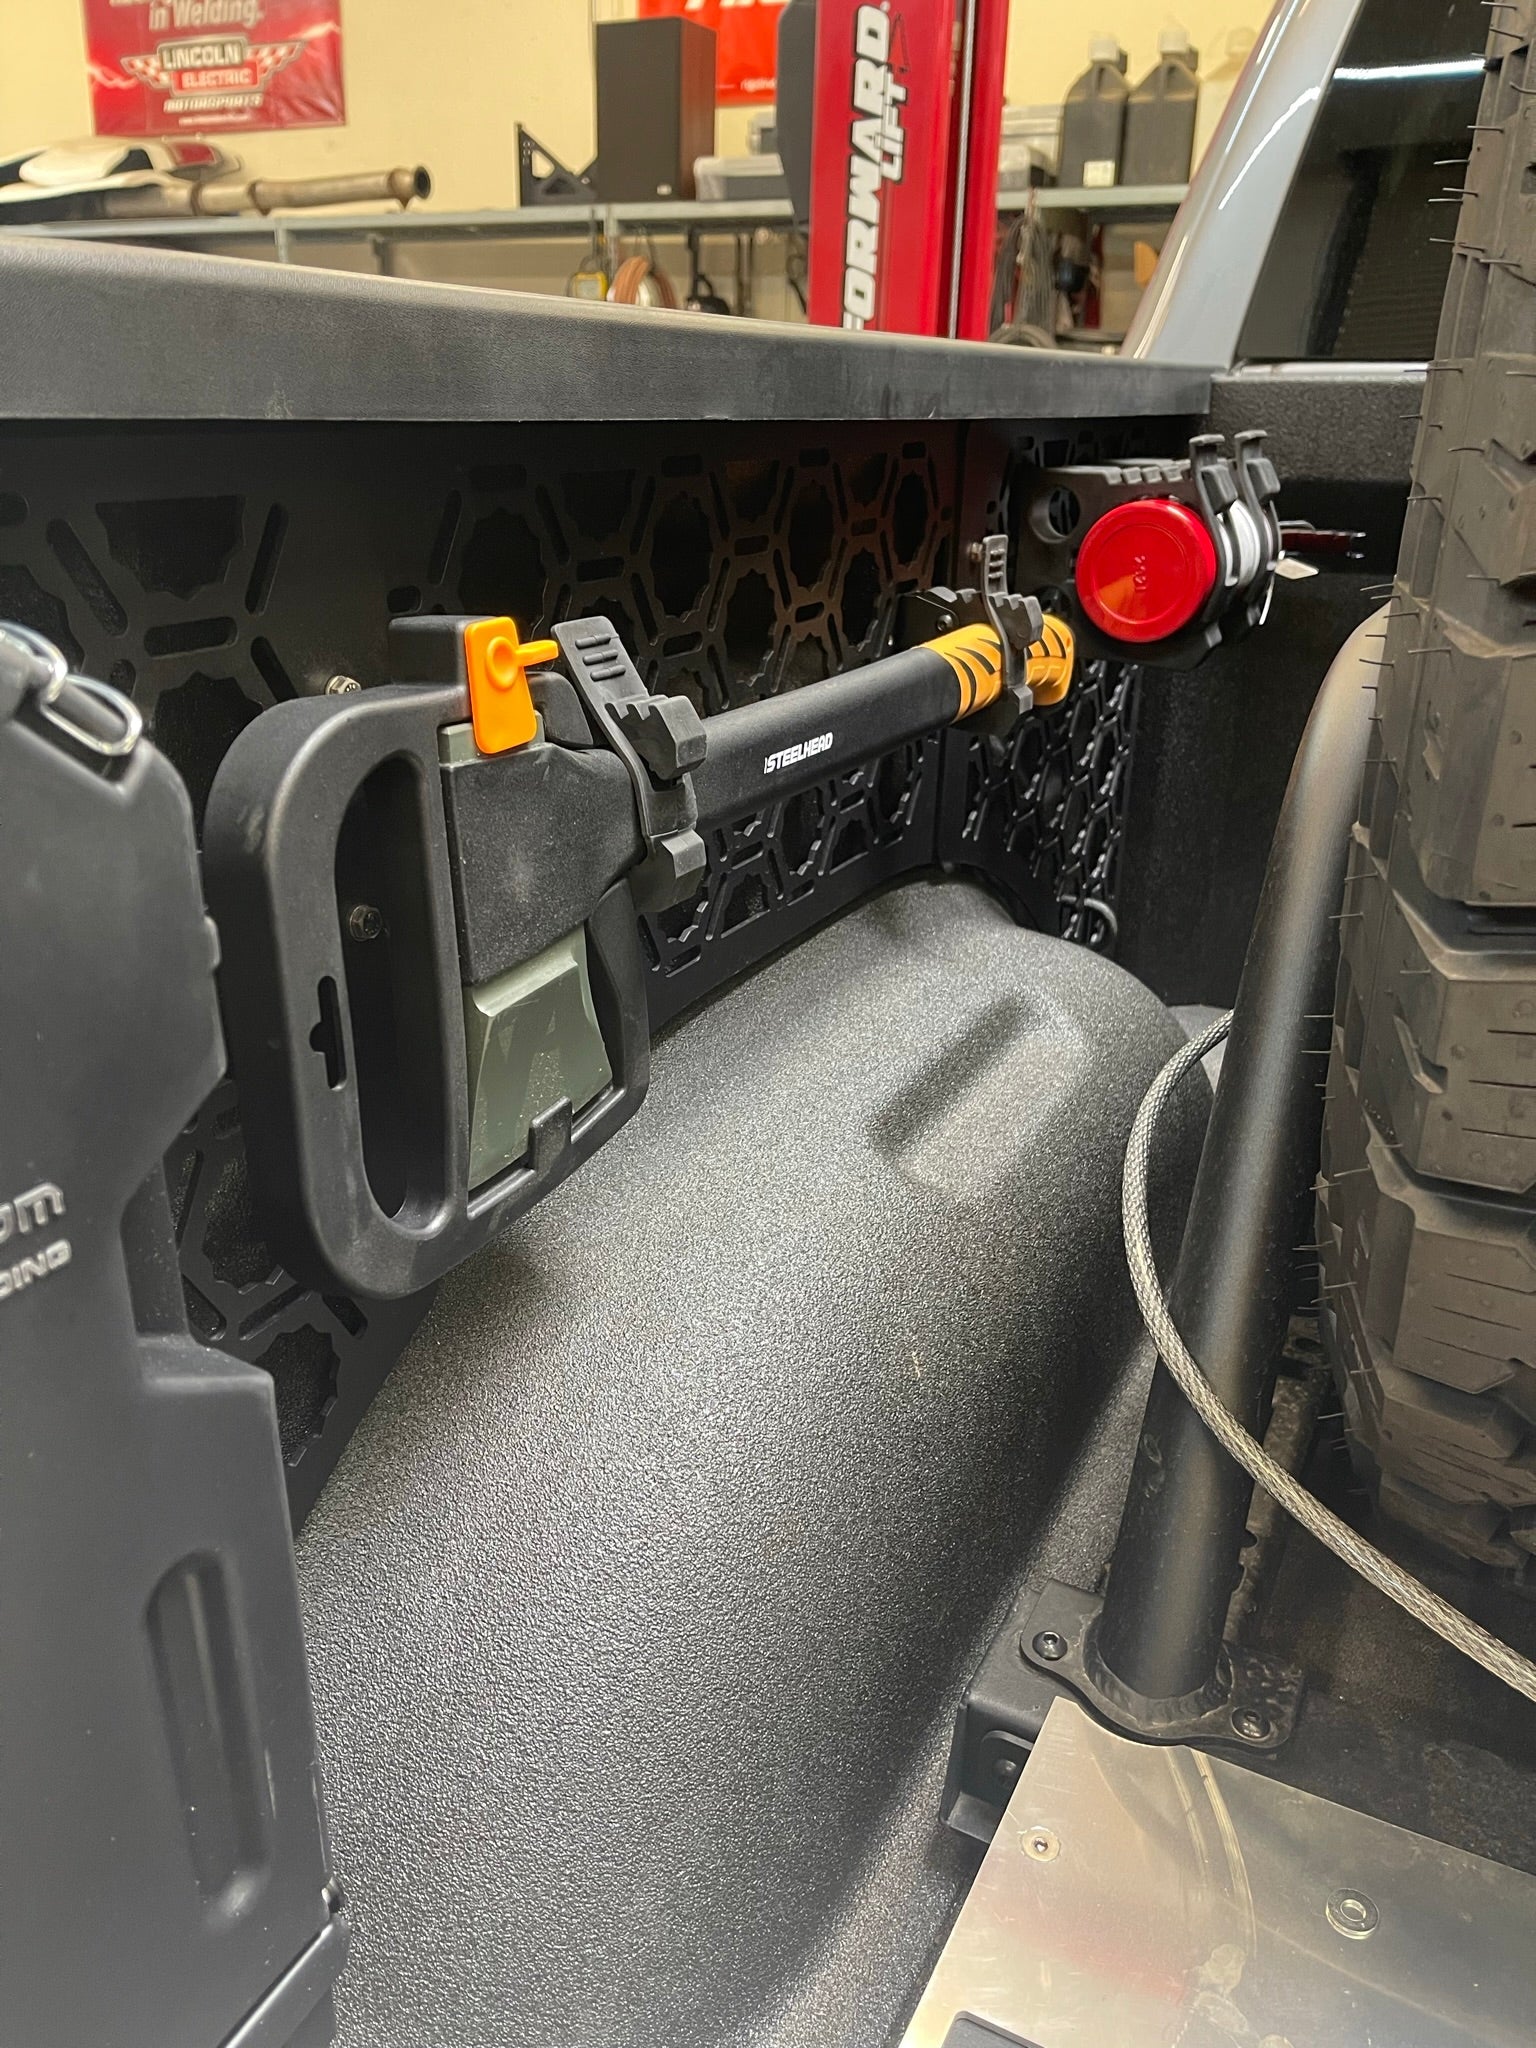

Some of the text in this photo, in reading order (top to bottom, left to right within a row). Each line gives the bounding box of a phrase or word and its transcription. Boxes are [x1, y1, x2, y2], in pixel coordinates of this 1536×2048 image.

[162, 43, 240, 70] LINCOLN
[181, 68, 252, 89] ELECTRIC
[880, 67, 908, 182] LIFT
[843, 4, 890, 329] ORWARD
